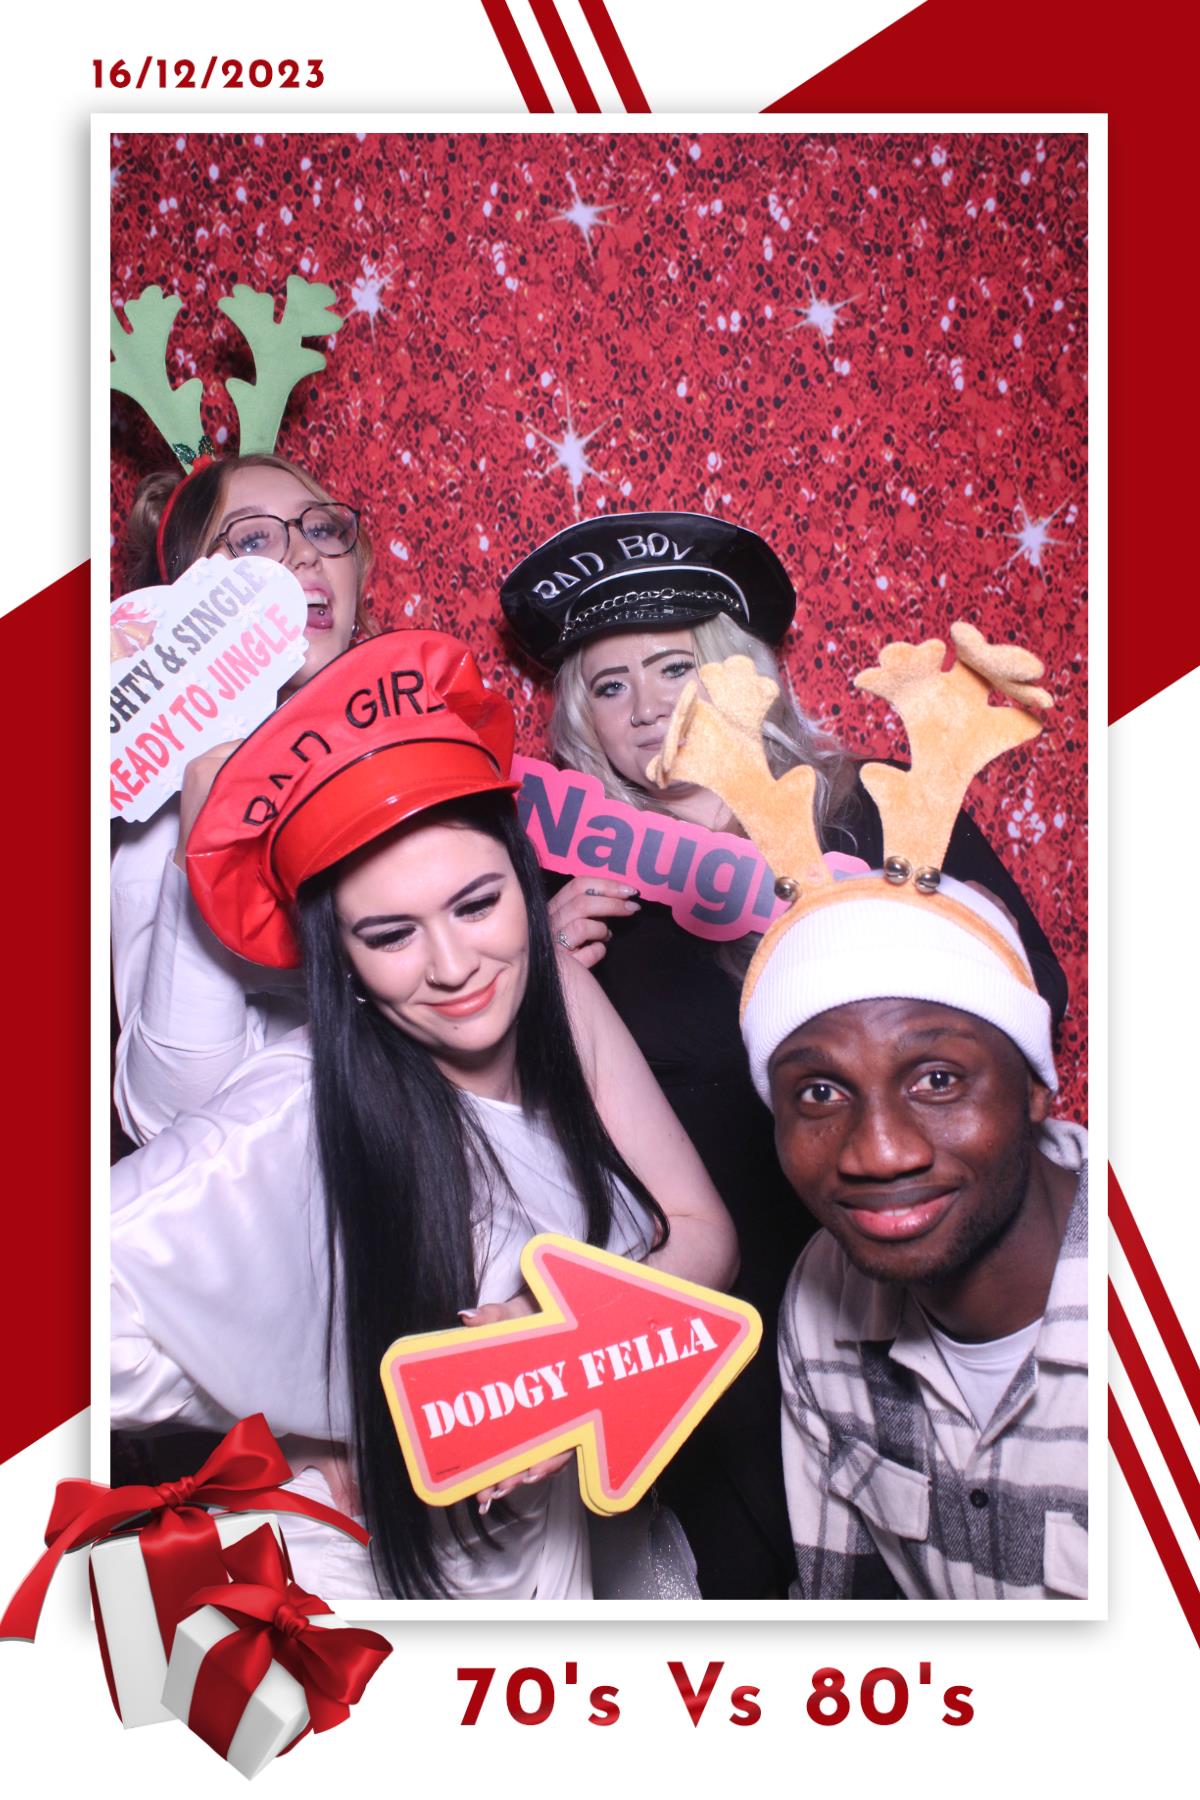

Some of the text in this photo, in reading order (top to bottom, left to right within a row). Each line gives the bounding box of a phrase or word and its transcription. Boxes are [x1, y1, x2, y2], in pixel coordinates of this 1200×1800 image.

[154, 643, 188, 674] &
[171, 560, 268, 655] SINGLE
[168, 683, 219, 732] TO
[207, 603, 300, 700] JINGLE
[421, 1316, 719, 1441] DODGY FELLA
